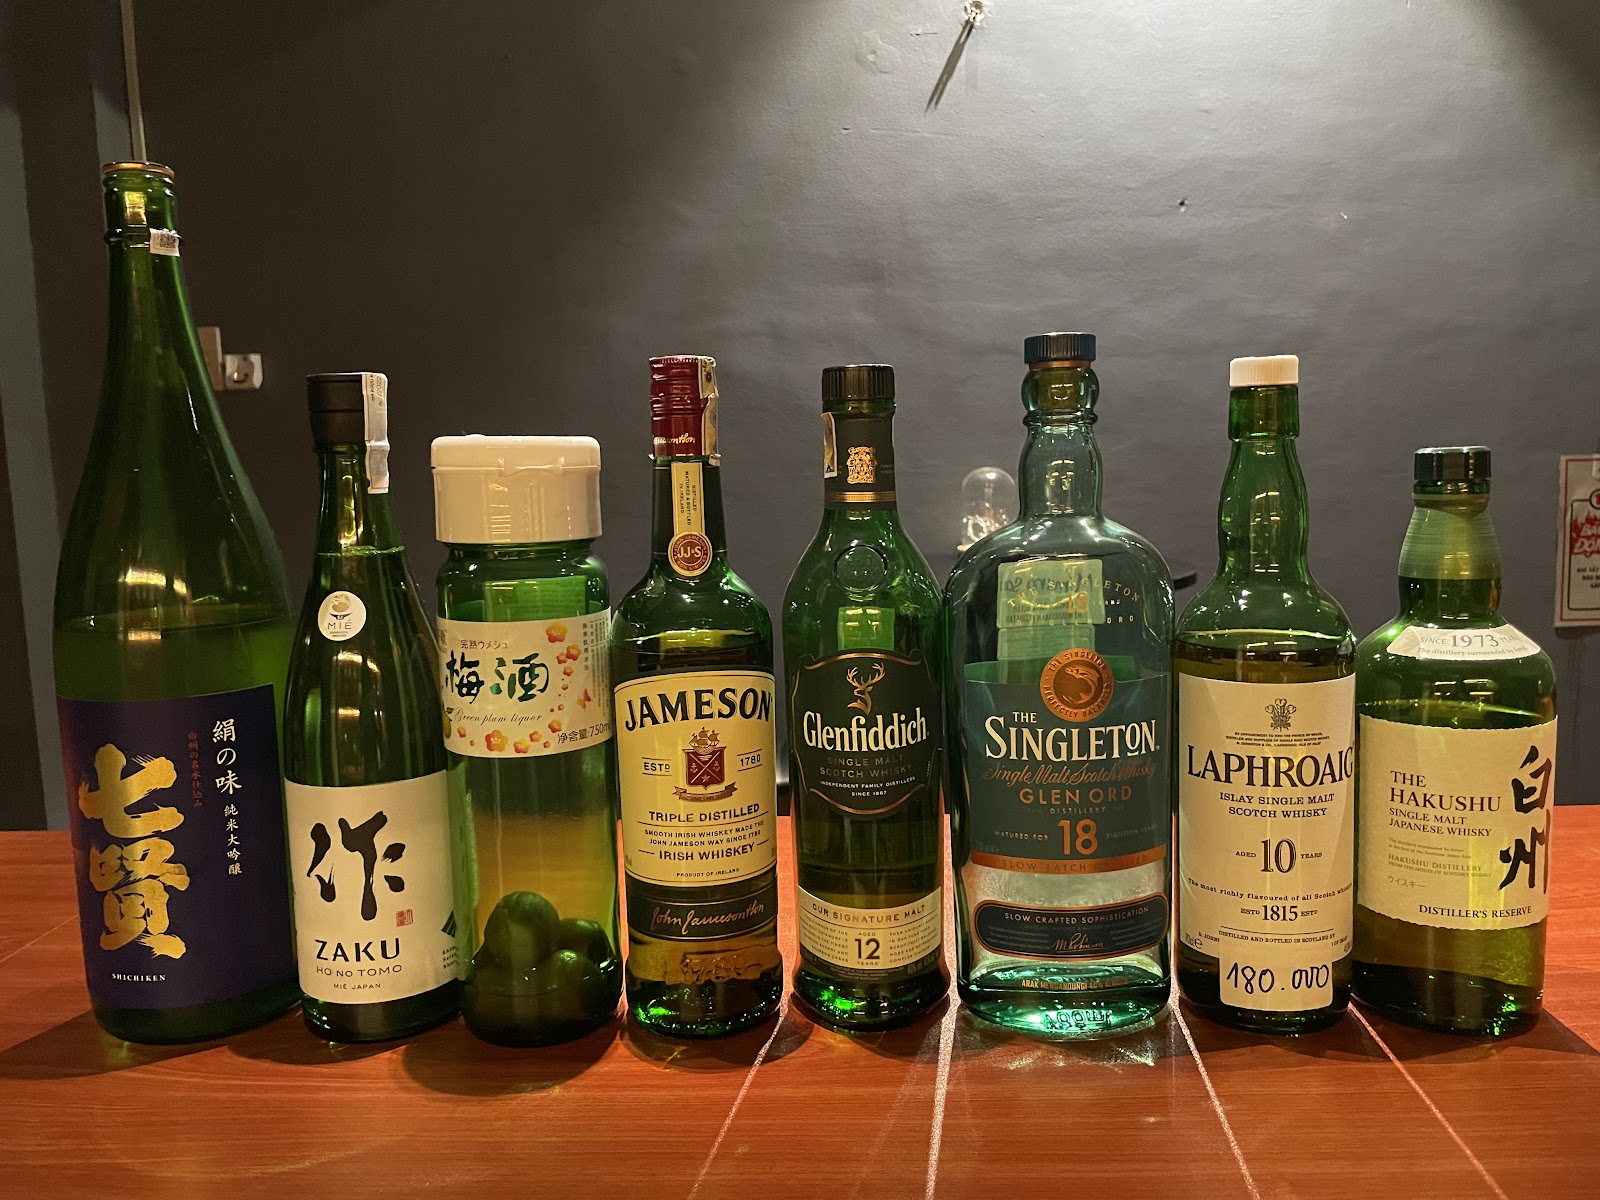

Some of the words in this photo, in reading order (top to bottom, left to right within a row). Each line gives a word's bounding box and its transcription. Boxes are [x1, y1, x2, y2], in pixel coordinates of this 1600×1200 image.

[460, 640, 508, 650] 完熟ウメシュ
[1420, 636, 1446, 644] SINCE
[1451, 634, 1499, 648] 1973
[446, 650, 550, 704] 梅酒
[453, 706, 480, 722] Green
[481, 713, 507, 725] plum
[511, 713, 542, 726] liquor
[625, 688, 771, 732] JAMESON
[1012, 712, 1037, 723] THE
[803, 707, 928, 751] Glenfiddich
[984, 716, 1156, 762] SINGLETON
[212, 718, 243, 795] 絹の味
[740, 754, 761, 766] 1780
[828, 756, 869, 766] SINGLE
[875, 754, 904, 764] MALT
[820, 767, 864, 778] SCOTCH
[870, 764, 912, 777] WHISKY
[984, 764, 1032, 786] Single
[1030, 763, 1070, 784] Malt
[1068, 762, 1116, 786] Scotch
[1117, 760, 1156, 781] Whisky
[1390, 770, 1426, 788] THE
[820, 780, 859, 789] INDEPENDENT
[886, 776, 916, 787] DISTILLERS
[1019, 788, 1080, 805] GLEN
[1089, 786, 1132, 804] ORD
[1219, 792, 1254, 803] ISLAY
[1258, 797, 1304, 805] SINGLE
[1308, 793, 1335, 804] MALT
[1389, 787, 1501, 812] HAKUSHU
[649, 811, 694, 823] TRIPLE
[700, 803, 760, 822] DISTILLED
[1228, 807, 1277, 818] SCOTCH
[1282, 808, 1327, 818] WHISKY
[1389, 807, 1430, 822] SINGLE
[1434, 815, 1467, 825] MALT
[1498, 745, 1552, 894] 白州
[644, 829, 673, 838] SMOOTH
[699, 828, 733, 838] WHISKEY
[735, 824, 753, 833] MADE
[1058, 818, 1098, 855] 18
[1389, 818, 1444, 834] JAPANESE
[1447, 827, 1492, 837] WHISKY
[224, 803, 243, 876] 純米大吟醸
[726, 835, 747, 843] SINCE
[79, 743, 191, 959] 七賢
[659, 850, 694, 861] IRISH
[698, 842, 755, 860] WHISKEY
[1261, 838, 1297, 873] 10
[306, 810, 406, 921] 作
[715, 868, 740, 876] IRELAND
[1002, 860, 1037, 870] SLOW
[1388, 854, 1429, 867] HAKUSHU
[1432, 862, 1482, 872] DISTILLERY
[1188, 878, 1199, 887] The
[1200, 884, 1217, 892] most
[1220, 888, 1244, 898] richly
[1314, 891, 1336, 900] Scotch
[1388, 875, 1426, 888] ウイスキー
[650, 906, 682, 931] John
[812, 903, 829, 916] OUR
[833, 912, 900, 923] SIGNATURE
[904, 904, 925, 919] MALT
[1004, 912, 1031, 922] SLOW
[1036, 915, 1077, 924] CRAFTED
[1081, 906, 1149, 924] SOPHISTICATION
[1262, 905, 1298, 921] 1815
[1419, 904, 1488, 918] DISTILLER'S
[1491, 906, 1532, 918] RESERVE
[1218, 930, 1248, 940] DISTILLED
[1302, 935, 1328, 943] SCOTLAND
[314, 937, 400, 962] ZAKU
[855, 938, 880, 960] 12
[112, 973, 166, 982] SHICHIKEN
[316, 966, 332, 976] HO
[357, 964, 403, 977] TOMO
[1226, 962, 1329, 994] 180.000
[1021, 979, 1039, 989] ARAK
